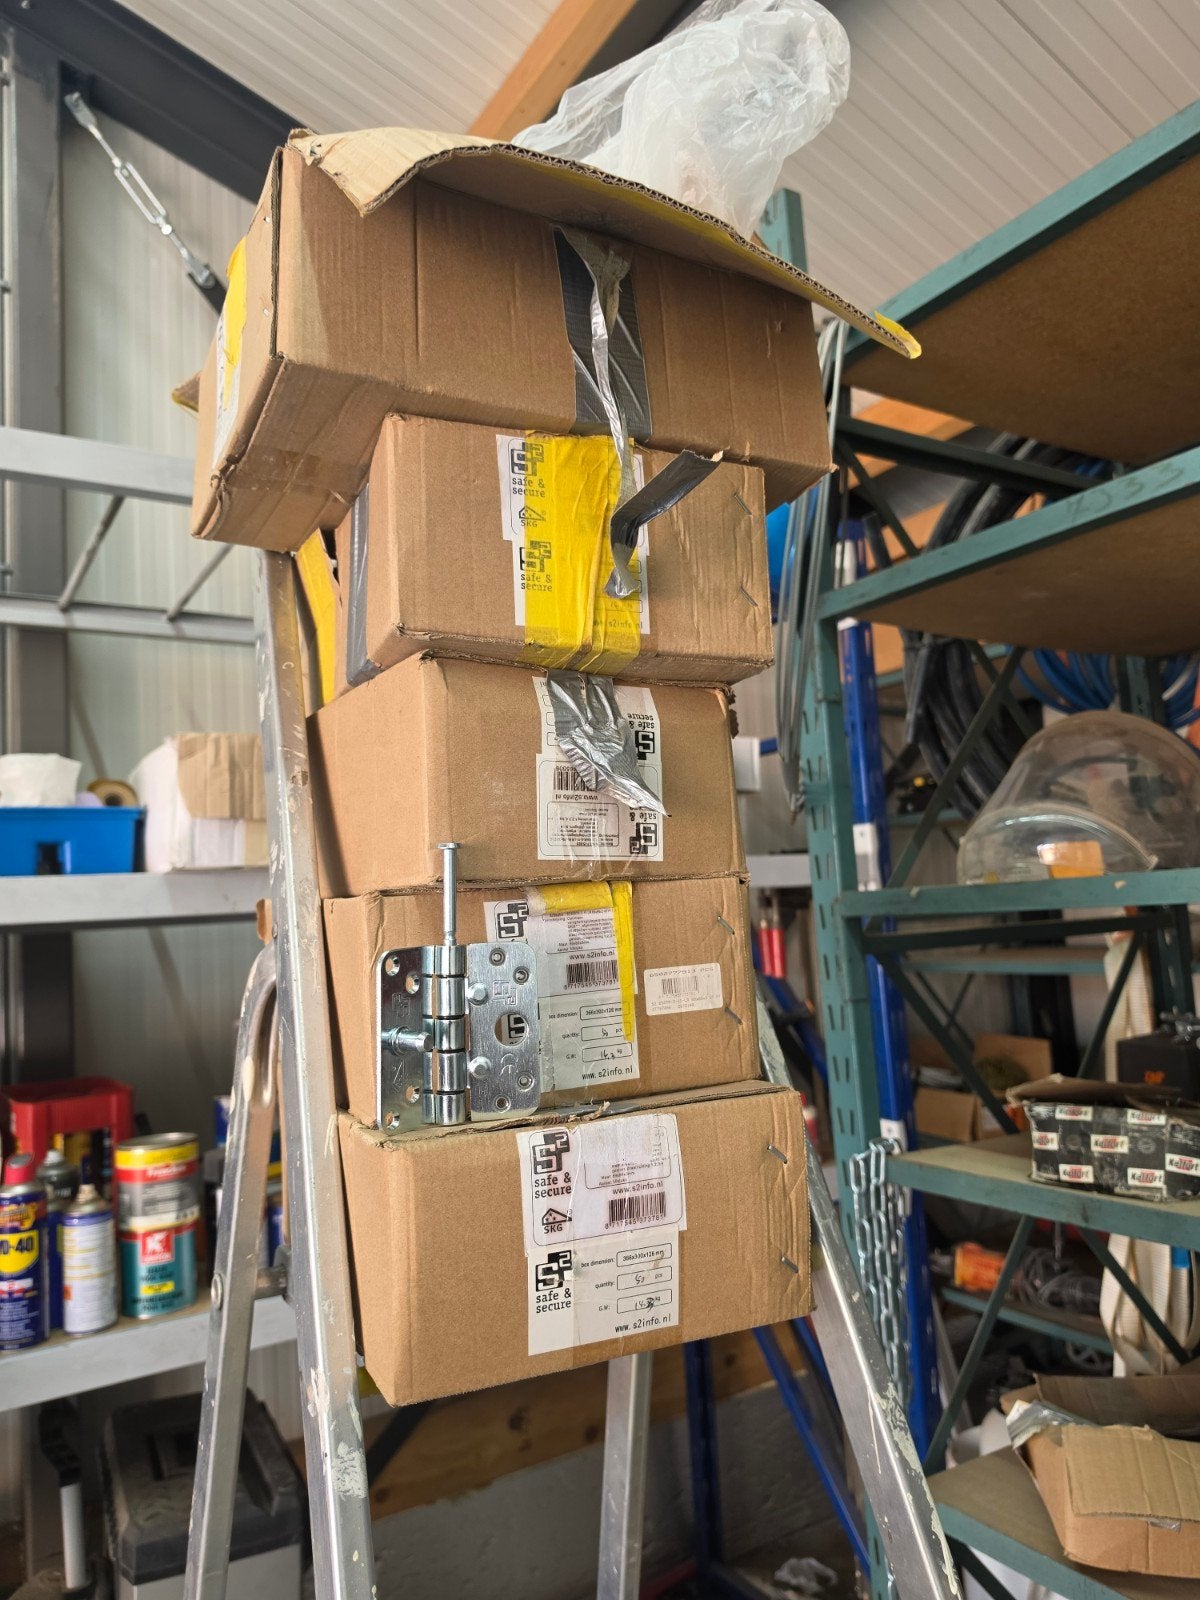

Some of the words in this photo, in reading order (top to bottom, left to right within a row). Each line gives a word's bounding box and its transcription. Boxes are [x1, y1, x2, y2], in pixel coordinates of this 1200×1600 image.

[512, 477, 533, 486] safe
[537, 479, 546, 488] &
[512, 487, 546, 498] secure
[521, 519, 538, 528] SKG
[521, 574, 541, 583] safe
[521, 582, 553, 592] secure
[627, 713, 654, 721] secure
[628, 720, 636, 729] &
[638, 721, 655, 730] safe
[641, 813, 657, 822] safe
[569, 950, 615, 960] www.s2info.nl
[582, 1065, 633, 1080] www.s2info.nl
[534, 1175, 559, 1188] safe
[563, 1172, 572, 1183] &
[534, 1185, 572, 1199] secure
[612, 1180, 664, 1195] www.s2info.nl
[543, 1223, 563, 1234] SKG
[536, 1291, 559, 1304] safe
[564, 1287, 572, 1298] &
[536, 1301, 572, 1314] secure
[614, 1313, 672, 1334] www.s2info.nl
